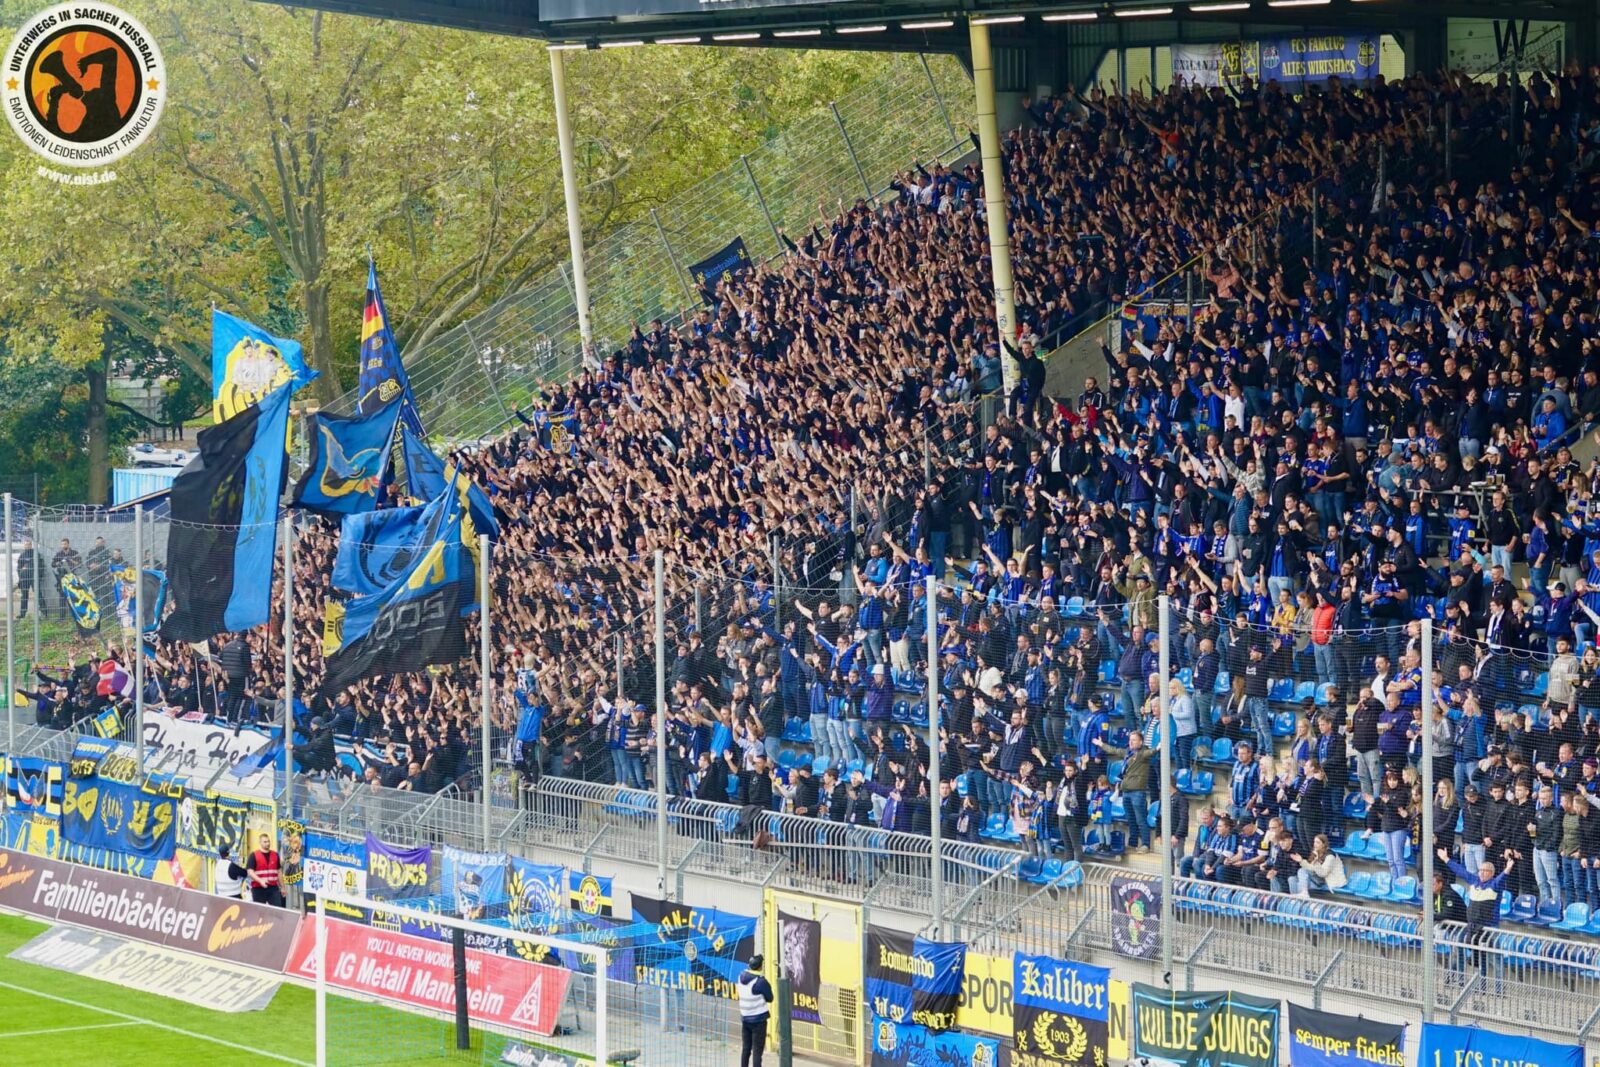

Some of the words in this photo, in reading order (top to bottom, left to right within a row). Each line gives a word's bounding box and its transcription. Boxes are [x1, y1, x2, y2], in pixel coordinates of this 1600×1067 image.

[1281, 61, 1306, 76] ALTES
[32, 870, 208, 941] Familienbäckerei
[367, 936, 395, 956] YOU'LL
[395, 944, 422, 964] NEVER
[657, 909, 725, 952] FAN-CLUB
[94, 947, 273, 1007] SPORTWETTEN
[880, 944, 935, 979] Kommando
[334, 953, 357, 980] IG
[359, 957, 412, 994] Metall
[410, 968, 505, 1015] Maneim
[1020, 960, 1105, 1011] Kaliber
[1051, 1029, 1070, 1044] 1903
[1139, 1004, 1198, 1051] WILDE
[1204, 1012, 1271, 1060] JUNGS
[1295, 1028, 1351, 1057] semper
[1355, 1036, 1404, 1067] fidelis
